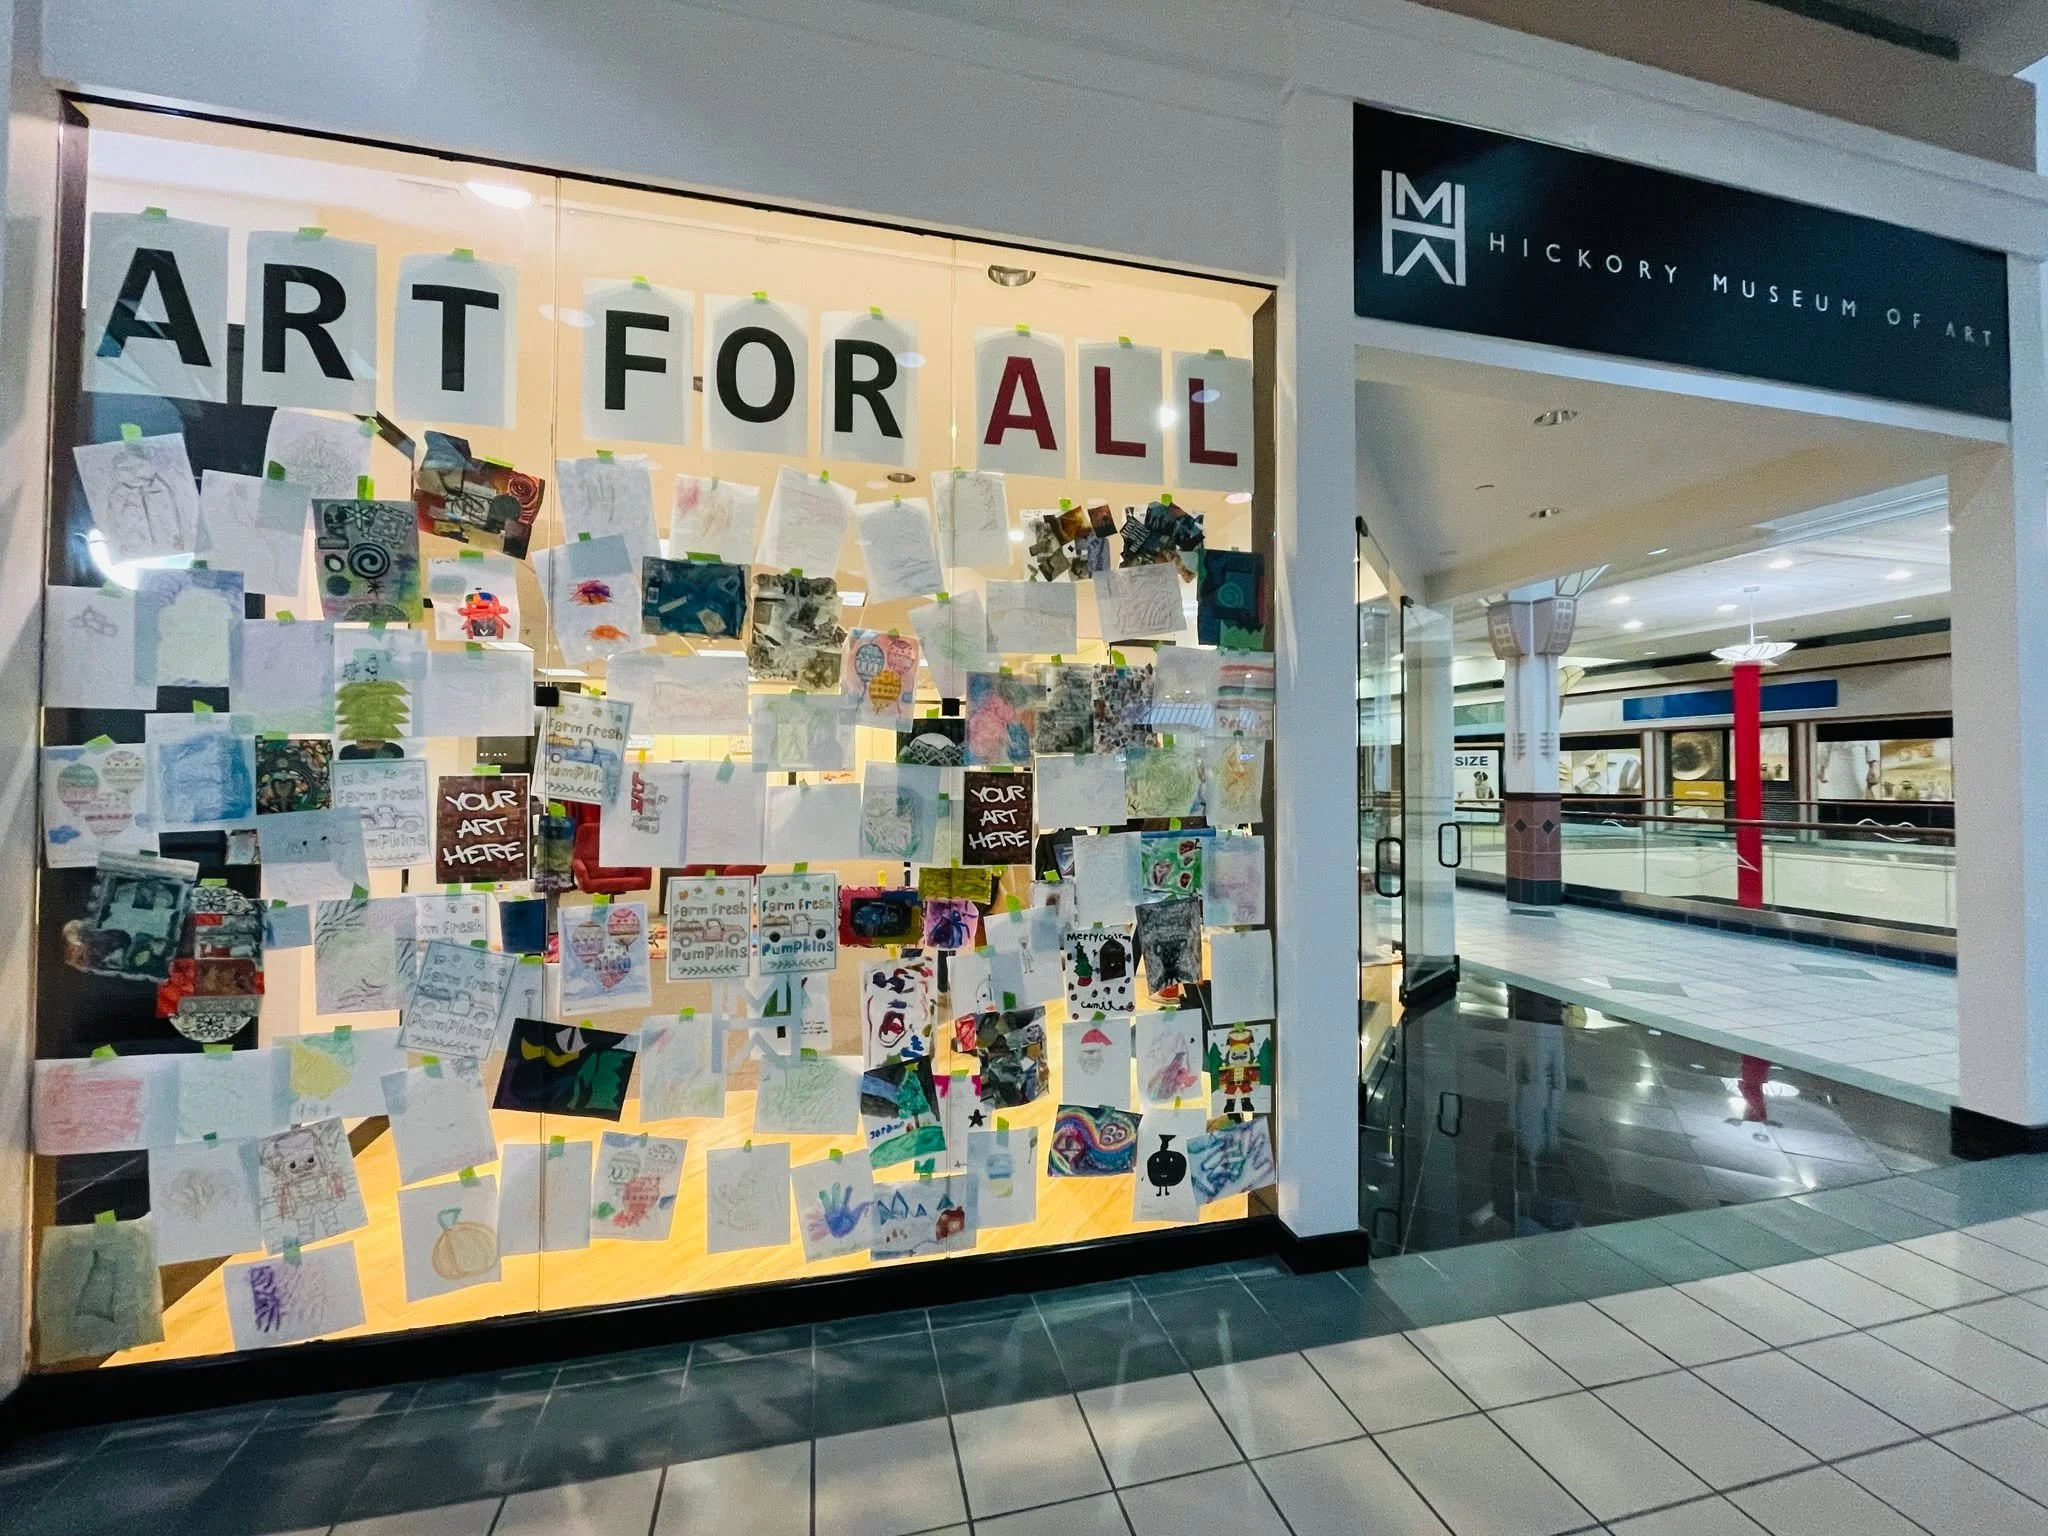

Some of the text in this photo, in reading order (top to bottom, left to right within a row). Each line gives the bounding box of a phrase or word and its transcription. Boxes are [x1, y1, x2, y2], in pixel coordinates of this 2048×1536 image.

[1489, 232, 1991, 347] HICKORY MUSEUM OF ART
[96, 247, 1238, 467] ART FOR ALL
[1455, 756, 1488, 766] SIZE
[445, 790, 518, 811] YOUR
[970, 785, 1026, 803] YOUR
[456, 817, 508, 838] ART
[979, 808, 1018, 827] ART
[968, 830, 1030, 850] HERE
[443, 841, 524, 866] HERE
